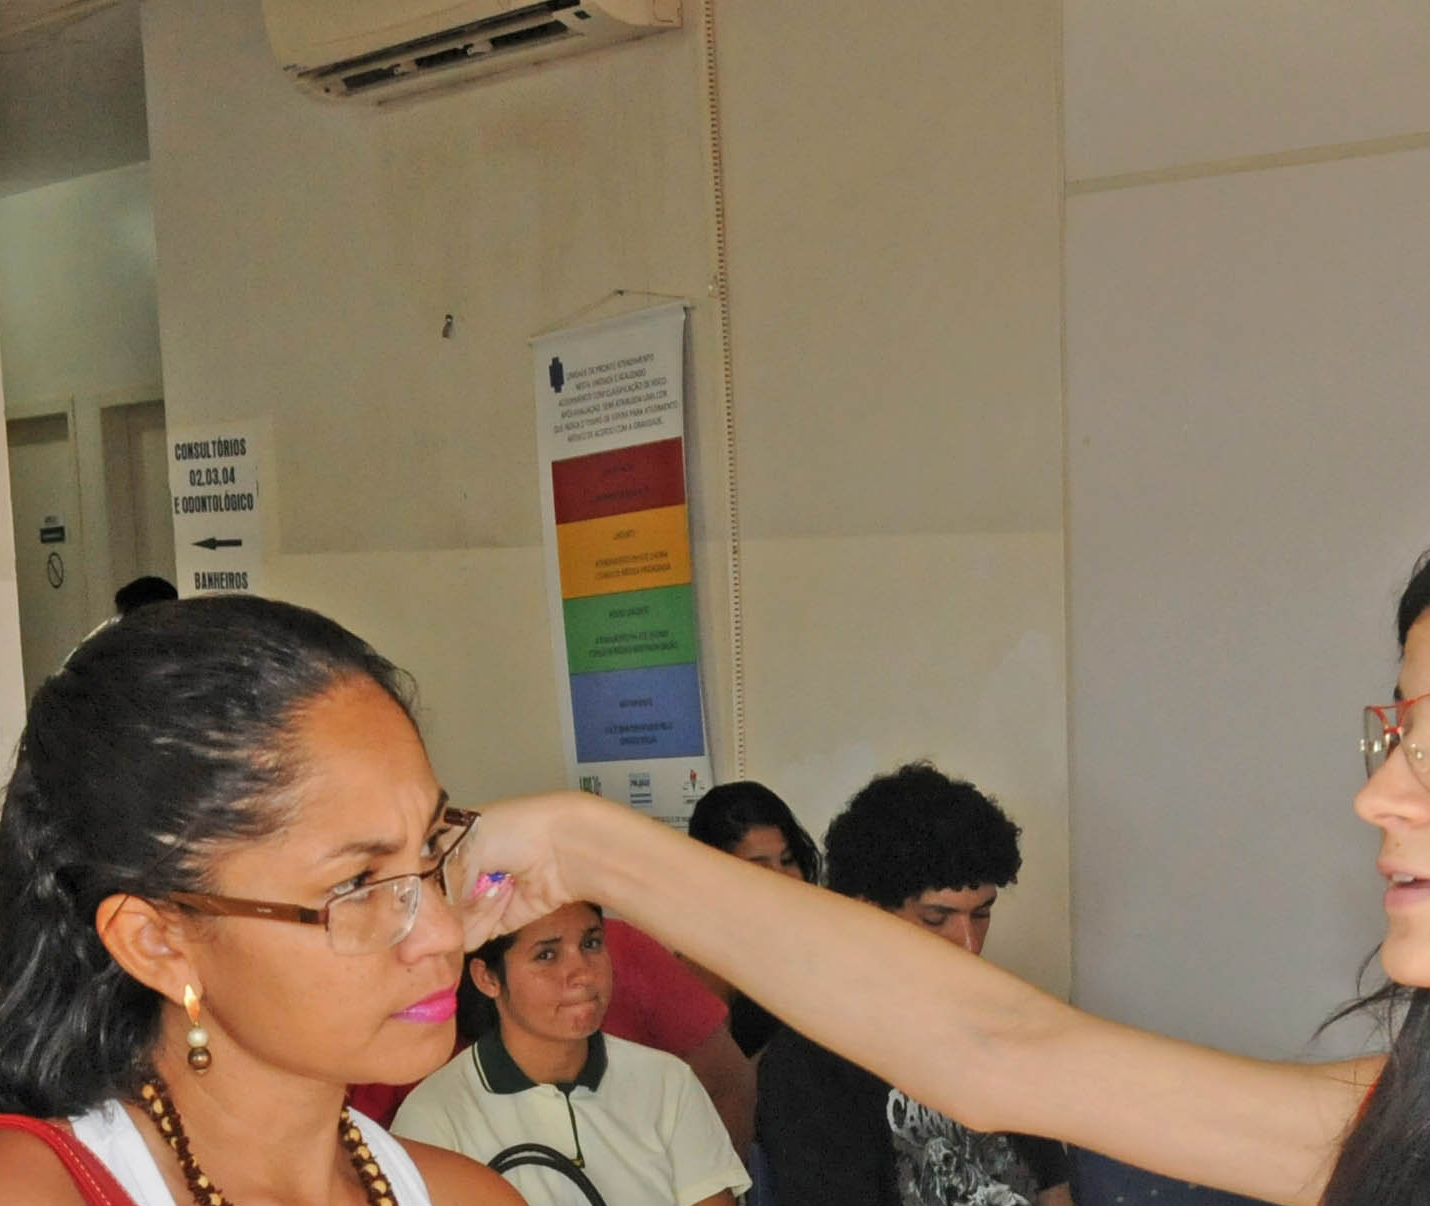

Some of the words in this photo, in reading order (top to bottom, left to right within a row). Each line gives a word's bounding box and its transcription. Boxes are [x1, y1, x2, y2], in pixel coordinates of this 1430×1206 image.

[174, 436, 247, 461] CONSULTÓRIOS
[174, 496, 181, 515] E
[182, 490, 254, 514] ODONTOLÓGICO
[194, 572, 249, 590] BANHEIROS
